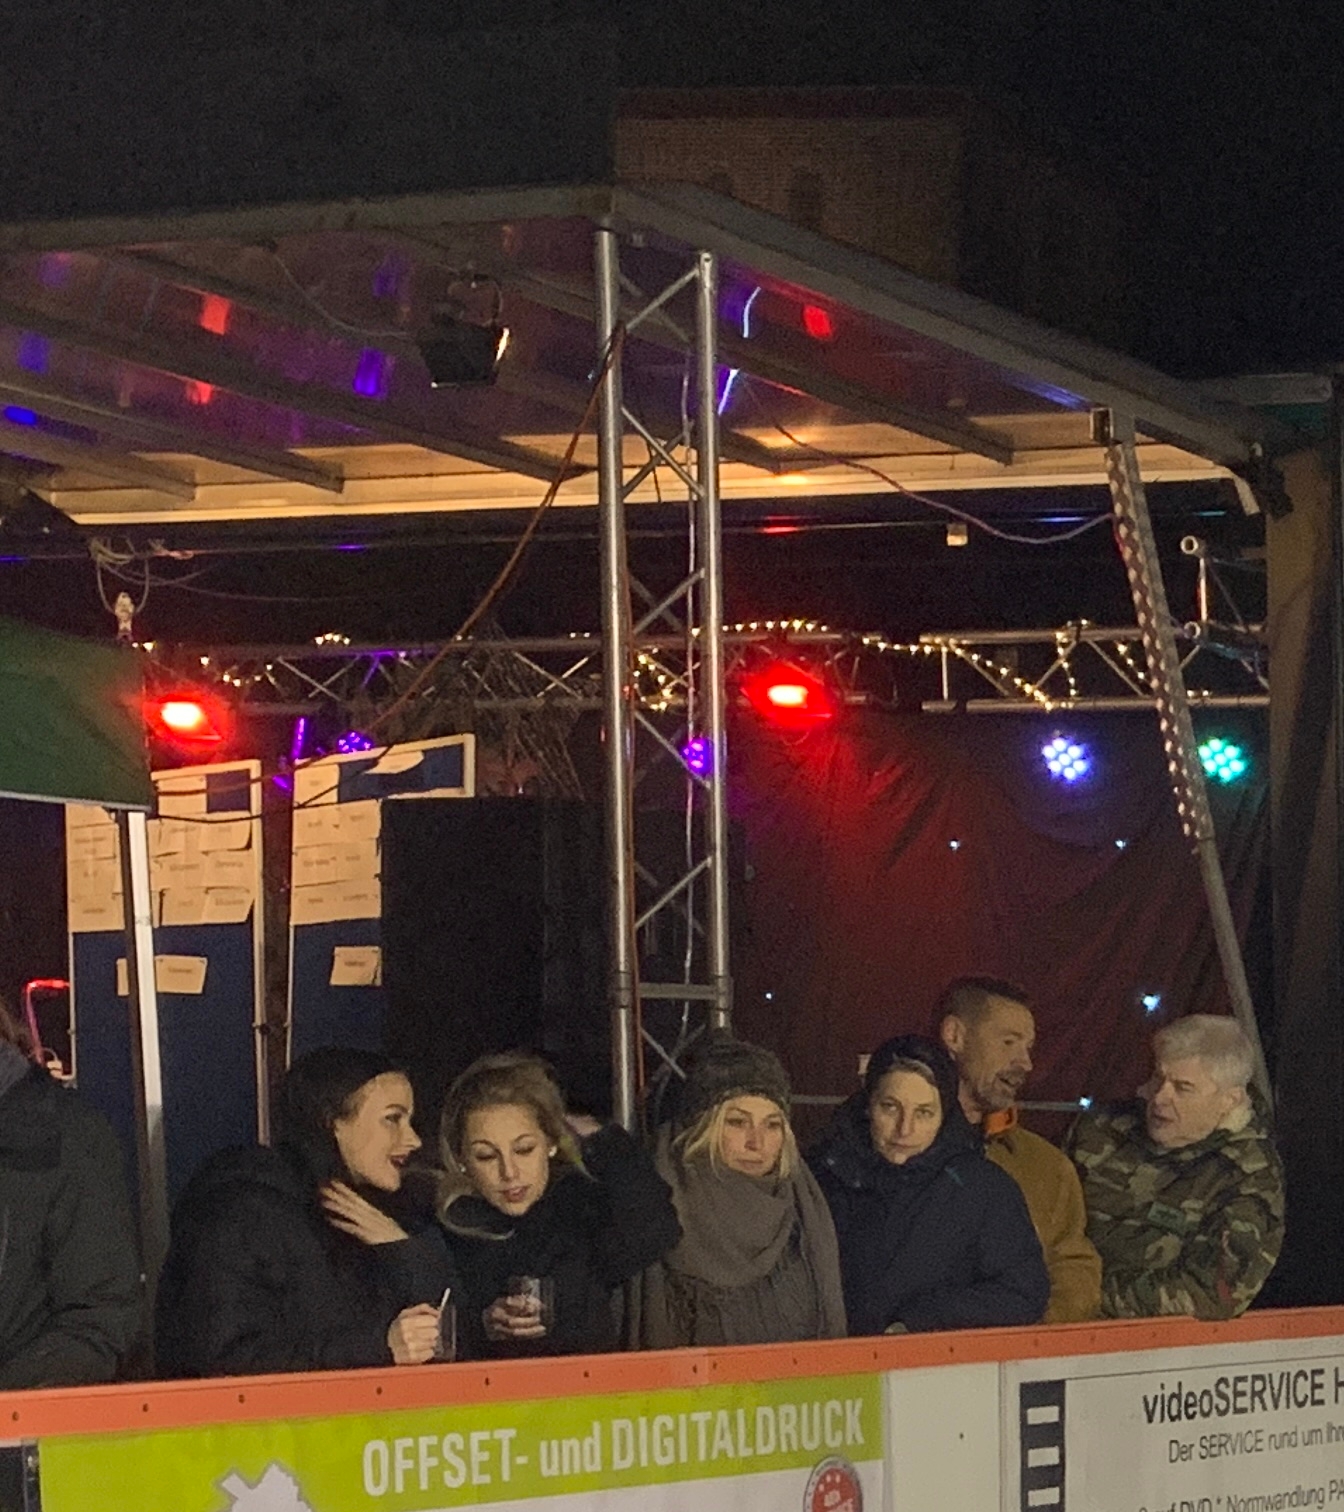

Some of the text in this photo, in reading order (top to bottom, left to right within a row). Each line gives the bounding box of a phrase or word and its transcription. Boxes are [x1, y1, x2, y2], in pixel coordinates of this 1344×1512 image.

[1142, 1368, 1325, 1424] videoSERVICE
[362, 1400, 865, 1497] OFFSET- und DIGITALDRUCK
[1168, 1439, 1195, 1464] Der
[1199, 1429, 1265, 1460] SERVICE
[1268, 1425, 1298, 1450] rund
[1302, 1428, 1323, 1447] um
